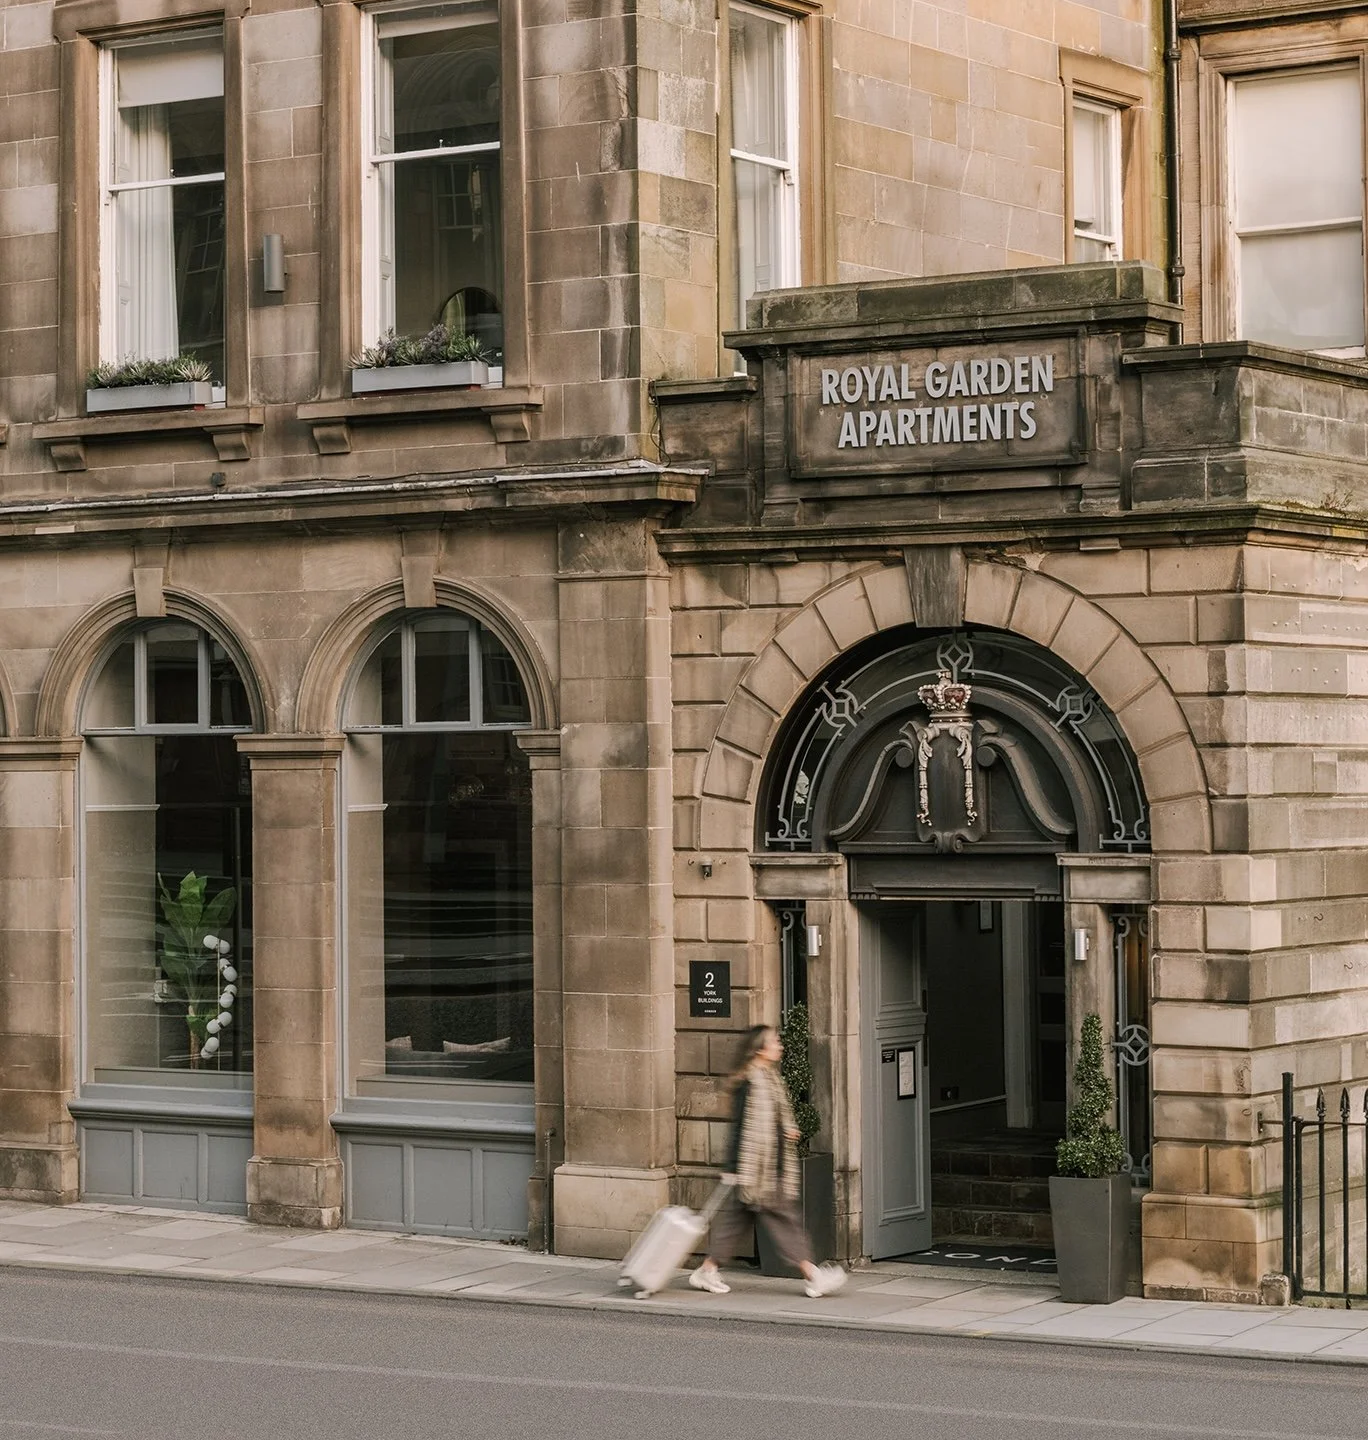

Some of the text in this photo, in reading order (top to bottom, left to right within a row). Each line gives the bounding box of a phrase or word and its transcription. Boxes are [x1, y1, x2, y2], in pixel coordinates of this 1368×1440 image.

[821, 354, 1054, 405] ROYAL GARDEN
[838, 401, 1037, 448] APARTMENTS
[705, 972, 714, 987] 2
